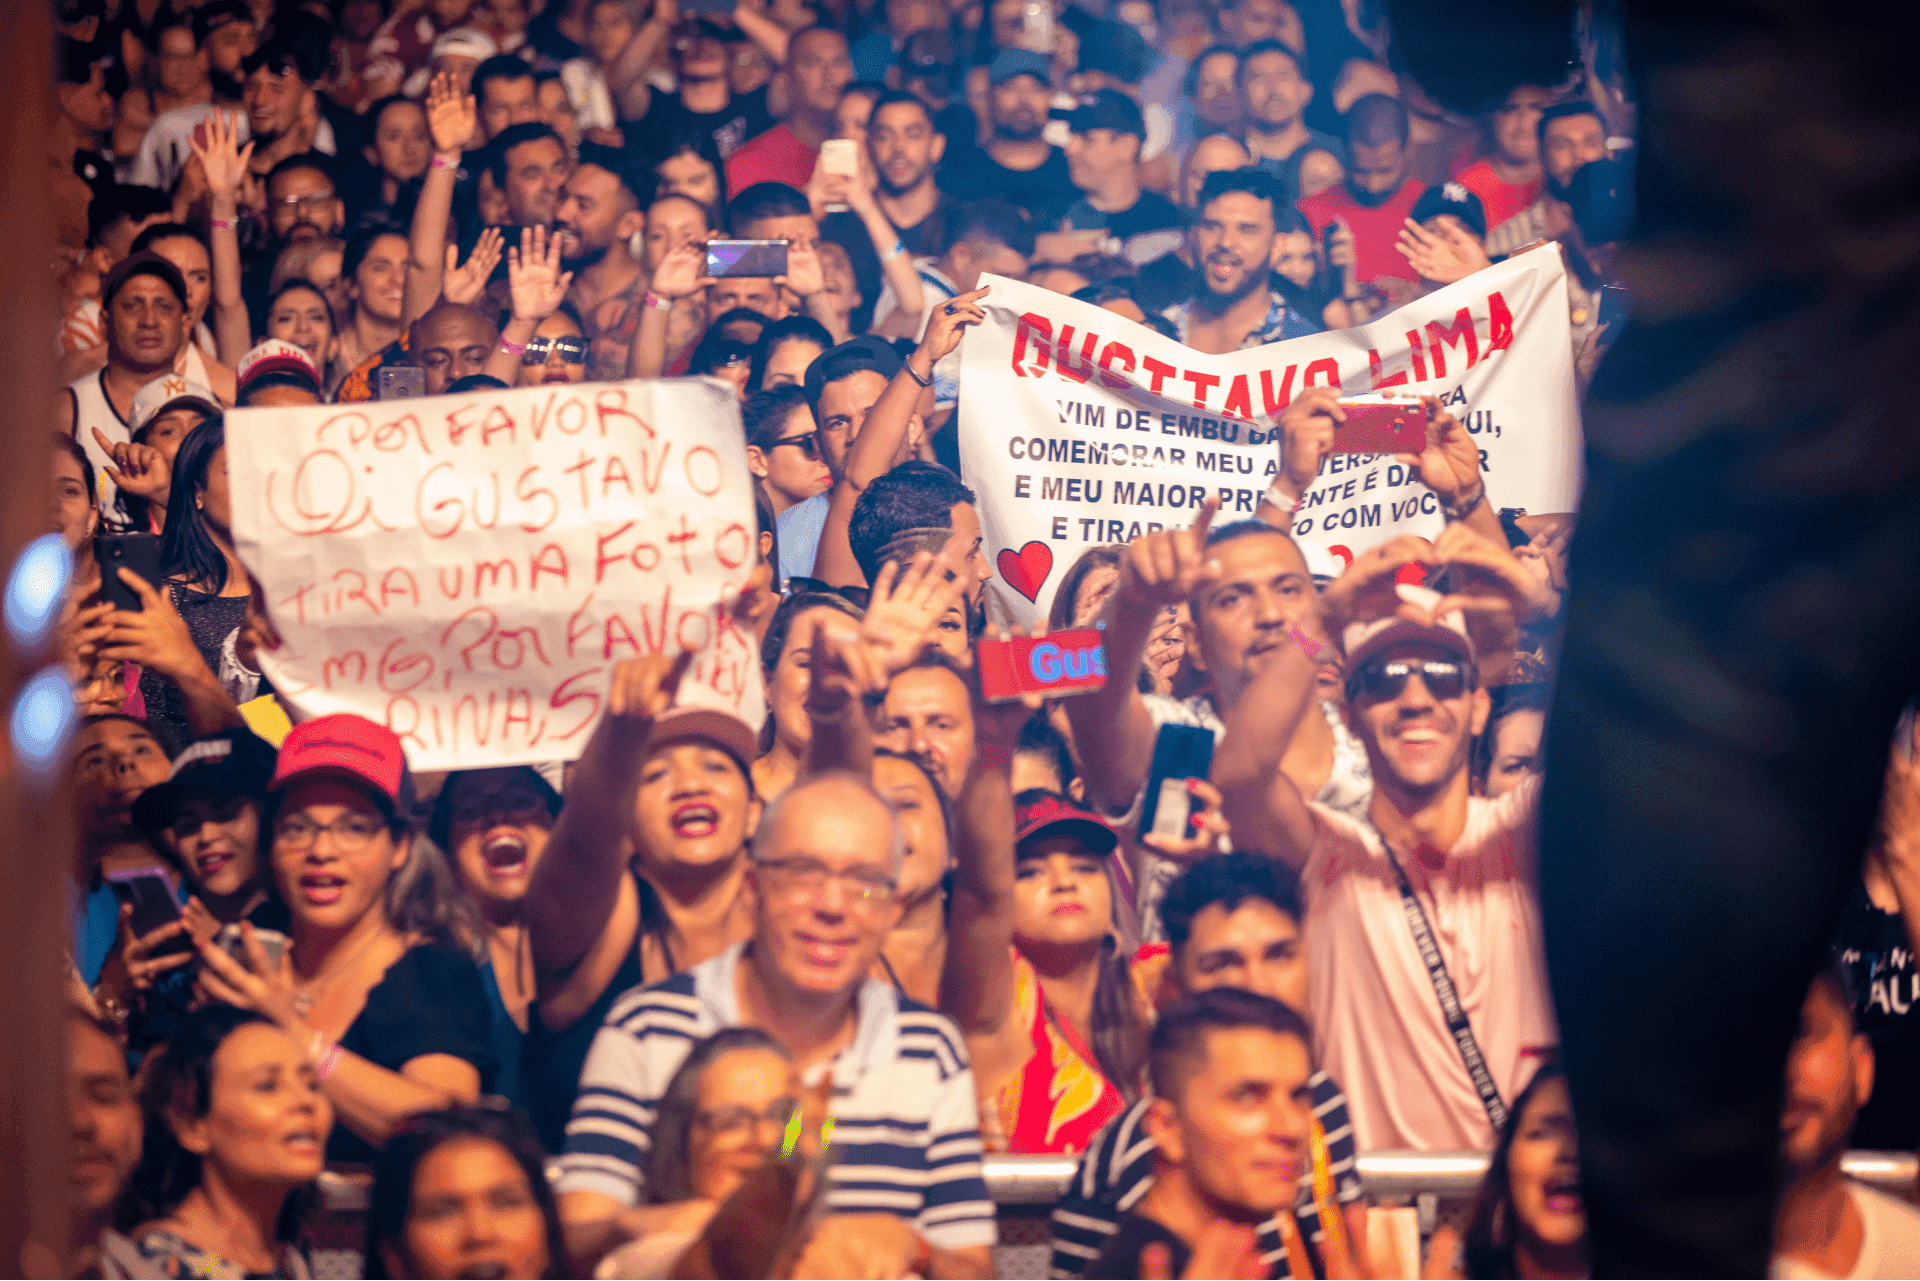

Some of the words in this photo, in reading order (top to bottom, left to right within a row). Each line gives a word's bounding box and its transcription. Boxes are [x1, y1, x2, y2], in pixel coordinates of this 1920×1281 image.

[1368, 291, 1514, 391] LIMA
[445, 388, 656, 447] FAVOR
[1056, 399, 1105, 427] VIM
[1116, 408, 1150, 433] DE
[1161, 413, 1239, 442] EMBU
[1009, 435, 1186, 468] COMEMORAR
[1196, 451, 1253, 475] MEU
[415, 441, 724, 540] GUSTAVO
[1014, 474, 1031, 498] E
[1041, 477, 1103, 503] MEU
[1113, 480, 1206, 509] MAIOR
[1364, 467, 1378, 492] É
[1051, 516, 1068, 540] E
[1323, 504, 1381, 531] COM
[1391, 492, 1437, 522] VOC
[440, 543, 568, 598] UMA
